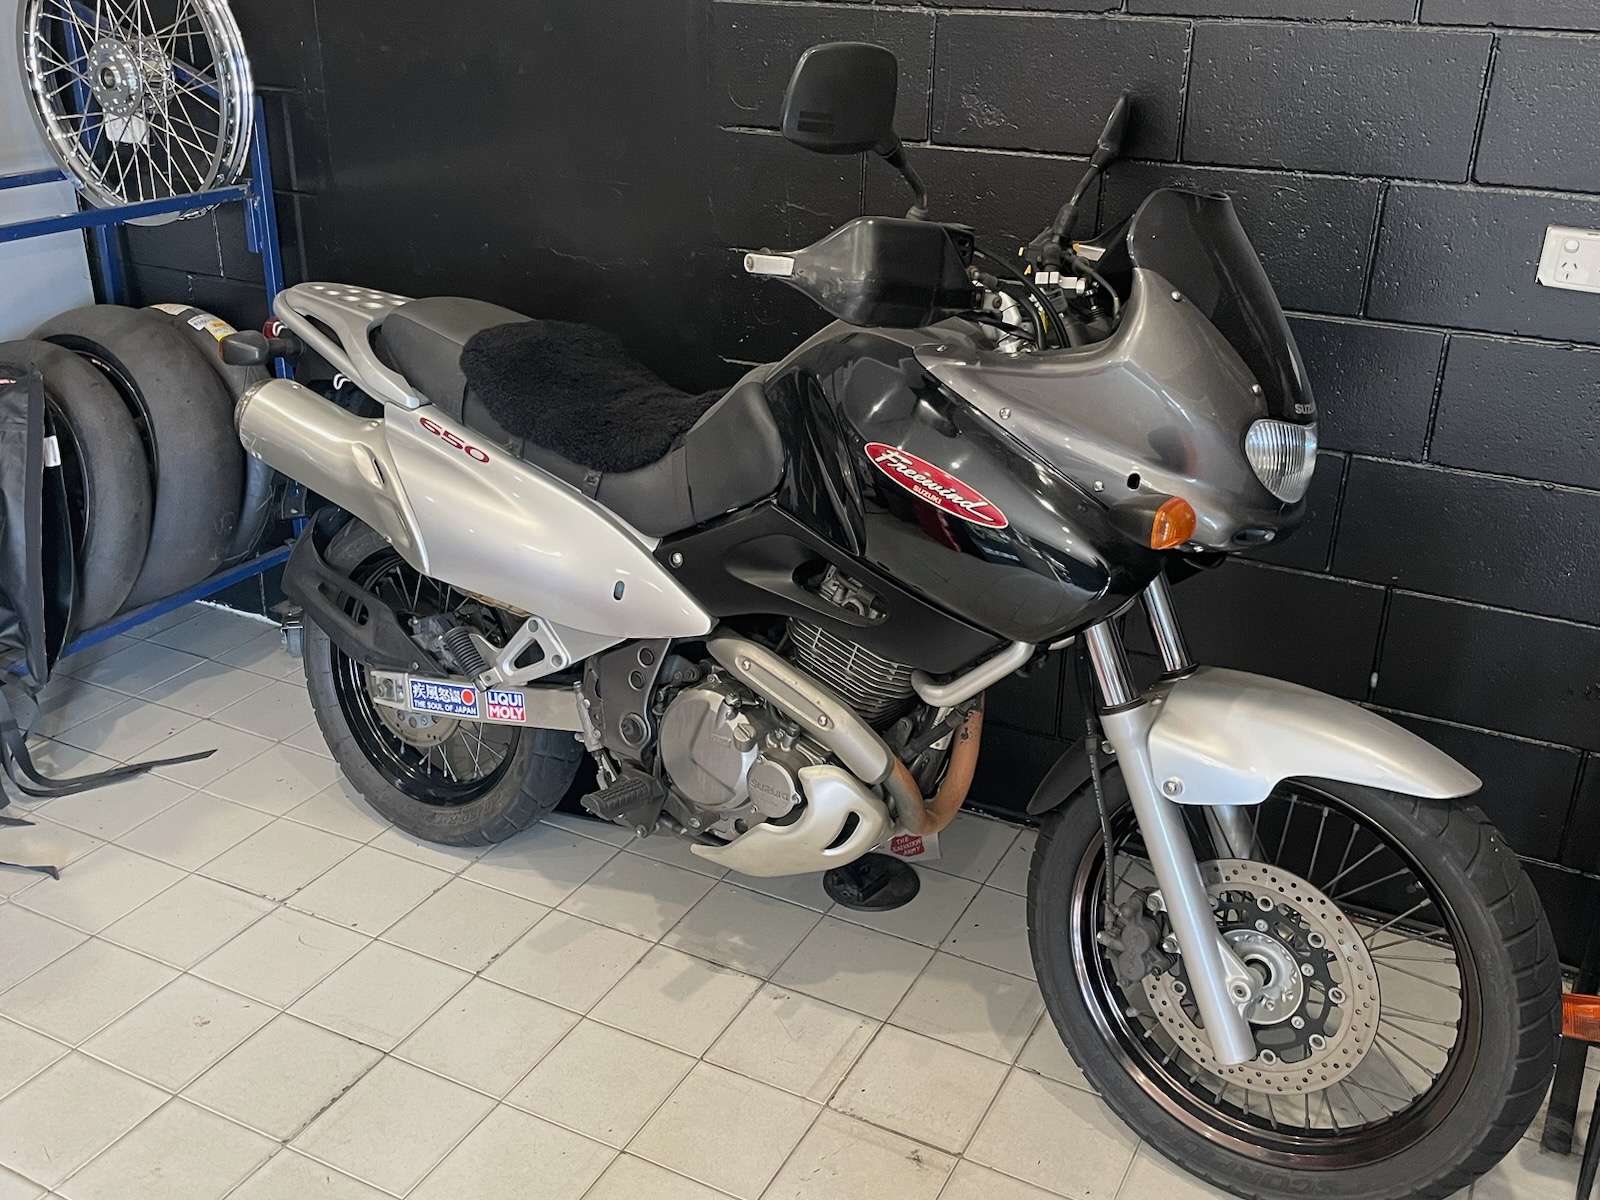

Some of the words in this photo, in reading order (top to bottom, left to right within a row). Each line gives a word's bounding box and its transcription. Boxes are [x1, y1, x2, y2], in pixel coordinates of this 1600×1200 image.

[419, 417, 490, 463] 650
[875, 449, 995, 521] Freewind
[912, 485, 942, 505] SUZUKI
[413, 699, 426, 709] THE
[427, 701, 444, 711] SOUL
[444, 703, 454, 712] OF
[454, 705, 477, 715] JAPAN
[487, 691, 523, 707] LIQUI
[489, 705, 524, 719] MOLY
[749, 779, 789, 801] SUZUKI
